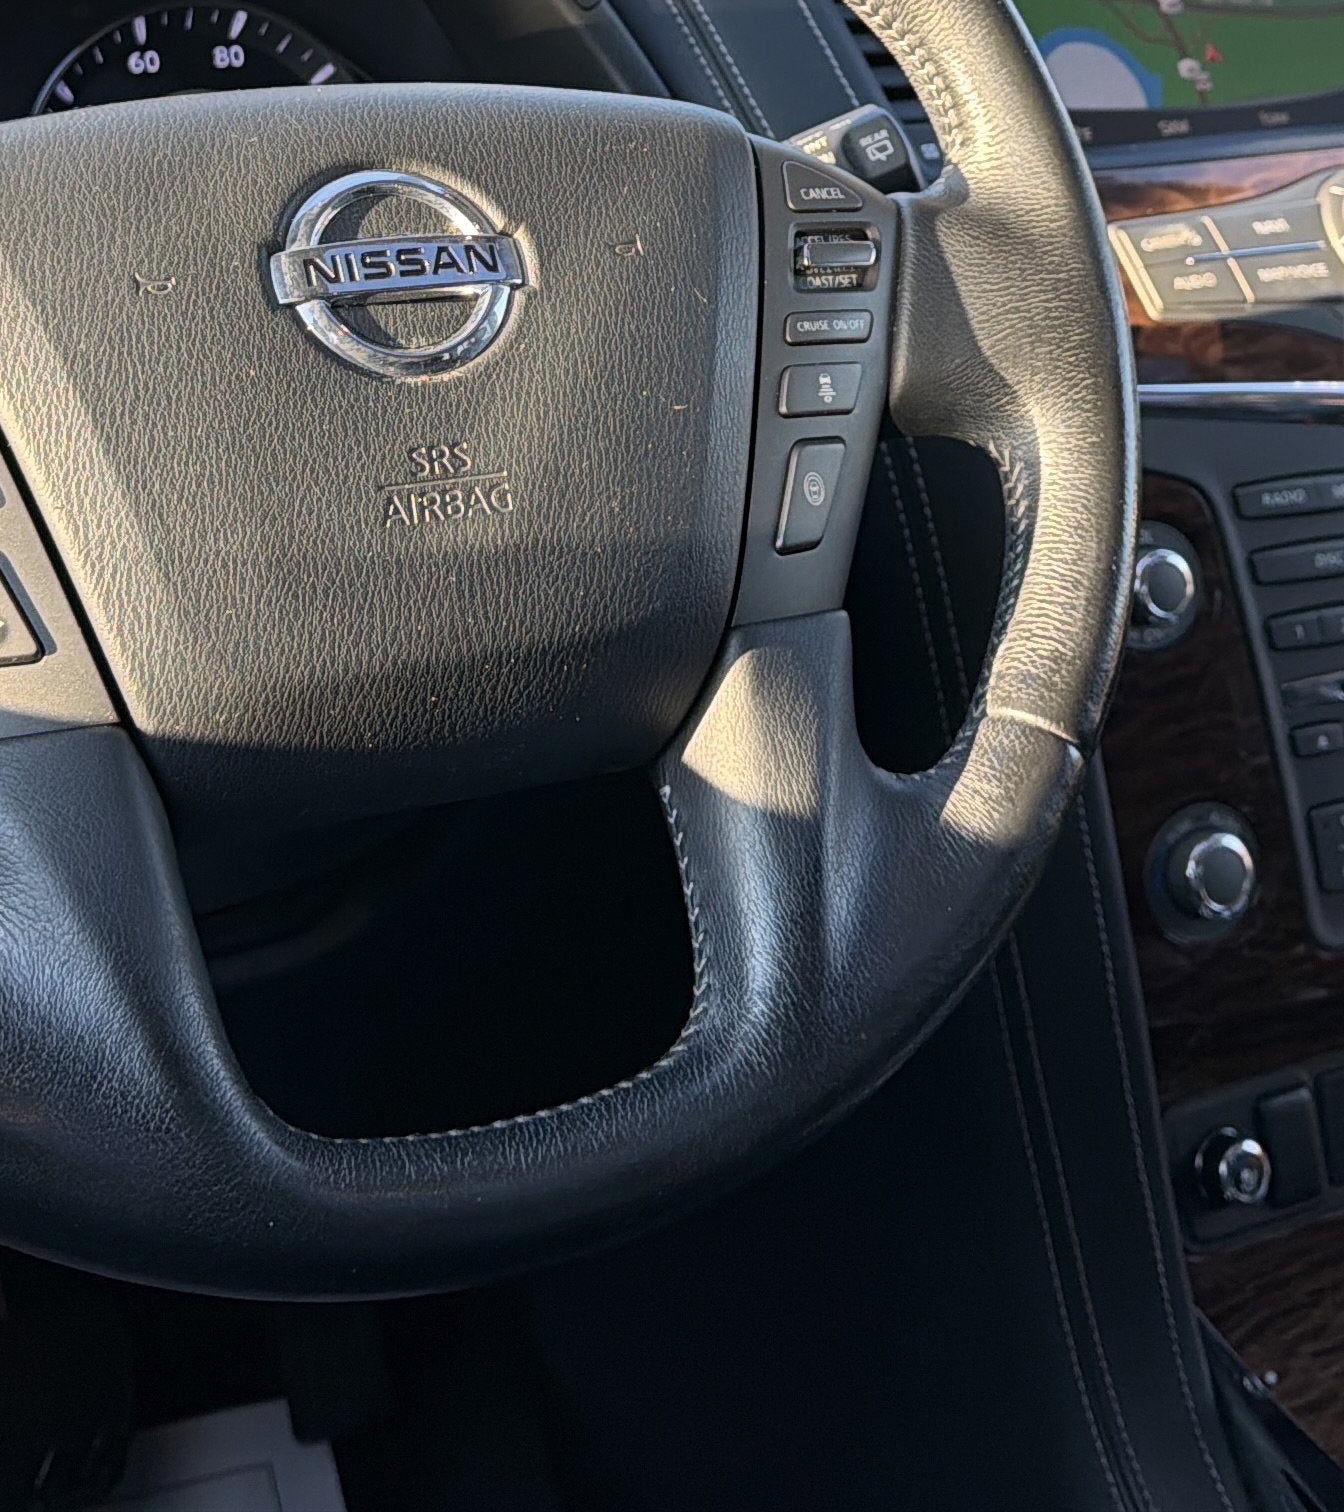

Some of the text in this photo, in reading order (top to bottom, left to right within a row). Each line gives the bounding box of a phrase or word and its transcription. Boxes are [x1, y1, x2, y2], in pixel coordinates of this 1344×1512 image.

[126, 50, 160, 75] 60
[799, 187, 846, 200] CANCEL
[303, 243, 500, 287] NISSAN
[798, 273, 858, 290] COAST/SET
[796, 320, 830, 332] CRUISE
[411, 442, 473, 476] SRS
[385, 484, 514, 529] AIRBAG
